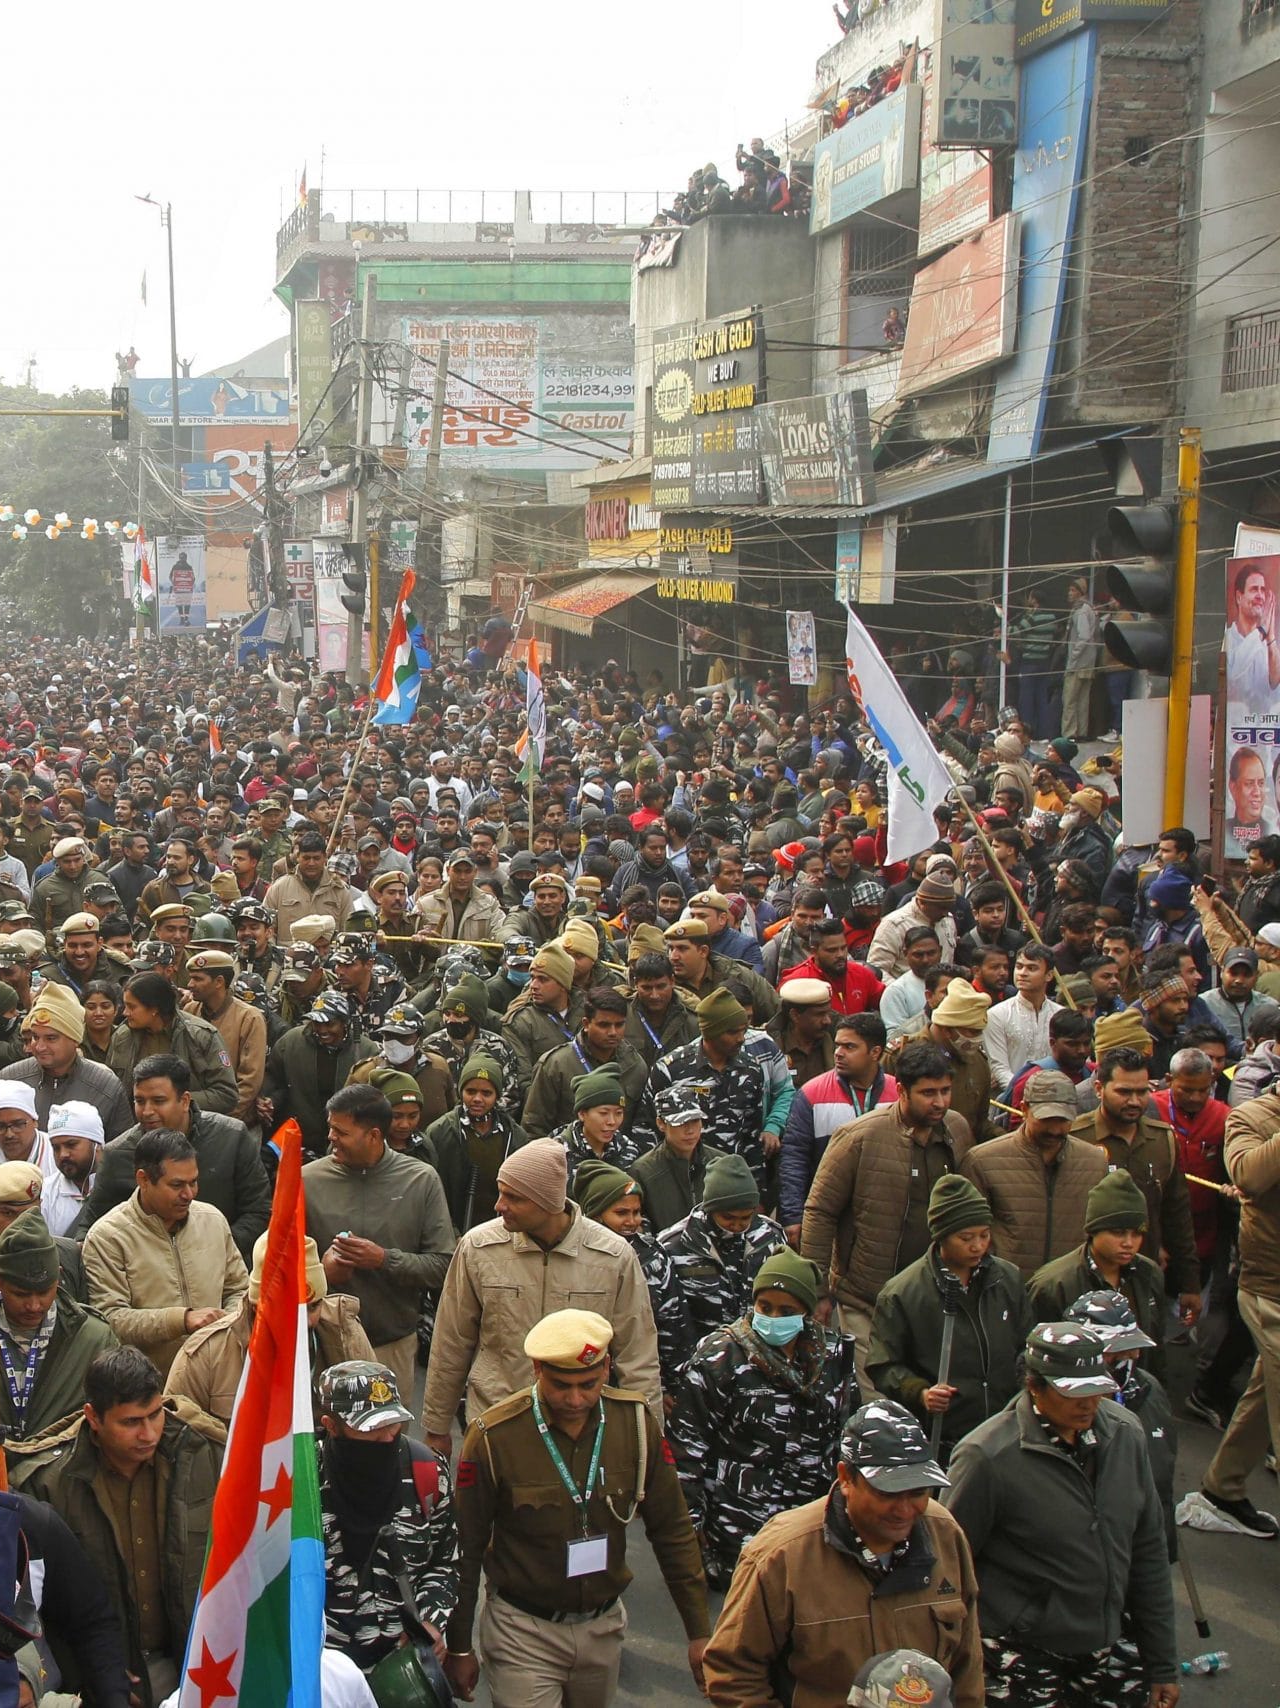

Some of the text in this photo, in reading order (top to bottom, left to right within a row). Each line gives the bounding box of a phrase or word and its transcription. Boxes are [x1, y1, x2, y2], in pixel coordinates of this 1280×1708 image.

[833, 144, 880, 185] THE PET STORE
[932, 283, 974, 327] Nova
[692, 331, 714, 360] CASH
[715, 327, 728, 355] ON
[729, 320, 753, 351] GOLD
[482, 368, 498, 378] GOLD
[707, 359, 735, 383] WE BUY
[188, 416, 213, 424] STORE
[561, 412, 627, 430] Castrol
[779, 422, 830, 458] LOOKS
[784, 461, 833, 480] UNISEX SALON
[586, 499, 626, 538] BIKANER
[658, 528, 732, 552] CASH ON GOLD
[678, 558, 689, 574] WE
